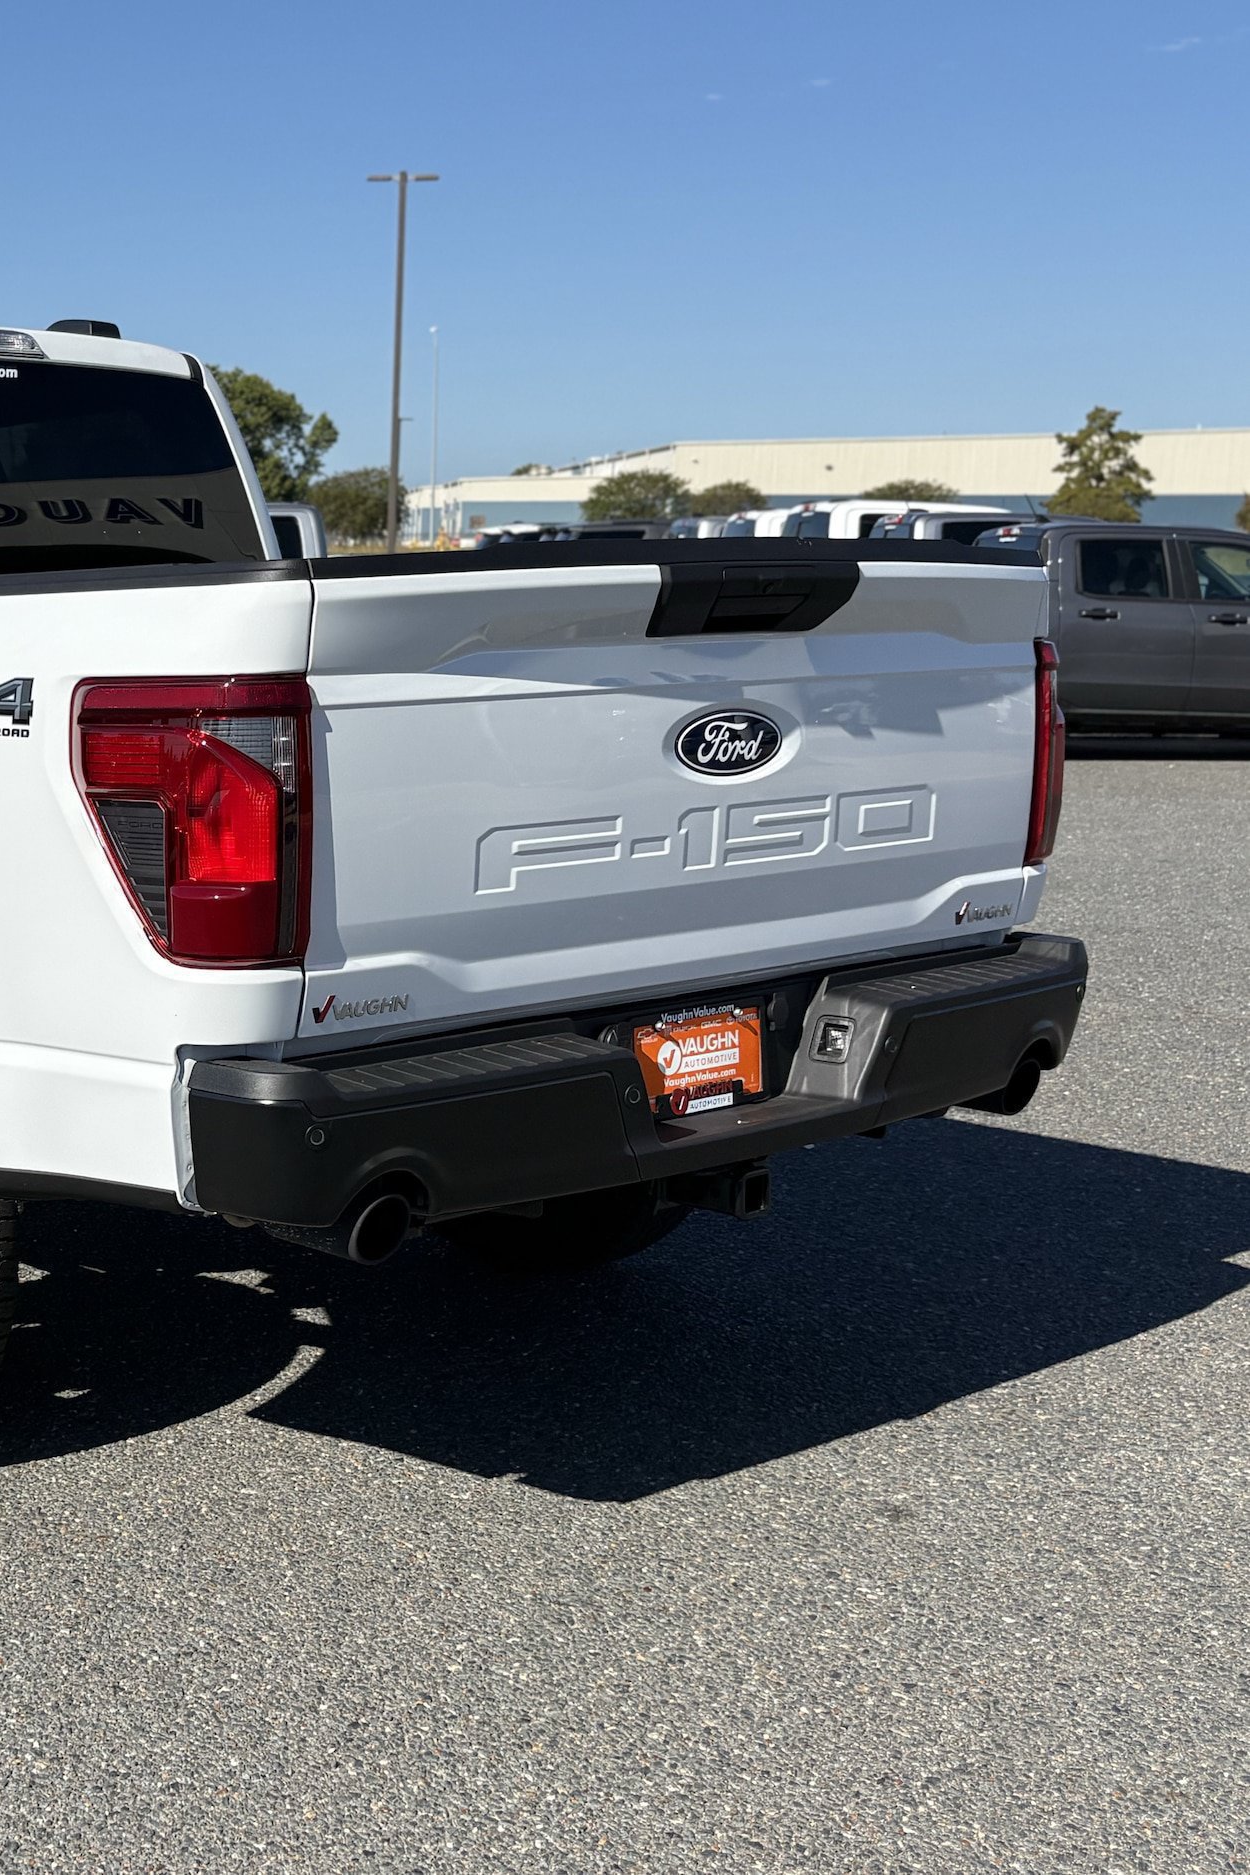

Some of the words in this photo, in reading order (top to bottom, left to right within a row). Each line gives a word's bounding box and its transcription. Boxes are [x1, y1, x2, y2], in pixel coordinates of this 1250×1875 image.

[697, 720, 764, 765] Ford
[474, 783, 937, 896] F-150
[332, 993, 410, 1020] VAUGHN
[661, 1004, 735, 1024] VaughnValue.com
[678, 1029, 739, 1055] VAUGHN
[683, 1053, 738, 1069] AUTOMOTIVE
[664, 1068, 736, 1088] VaughnValue.com
[690, 1095, 732, 1110] AUTOMOTIVE
